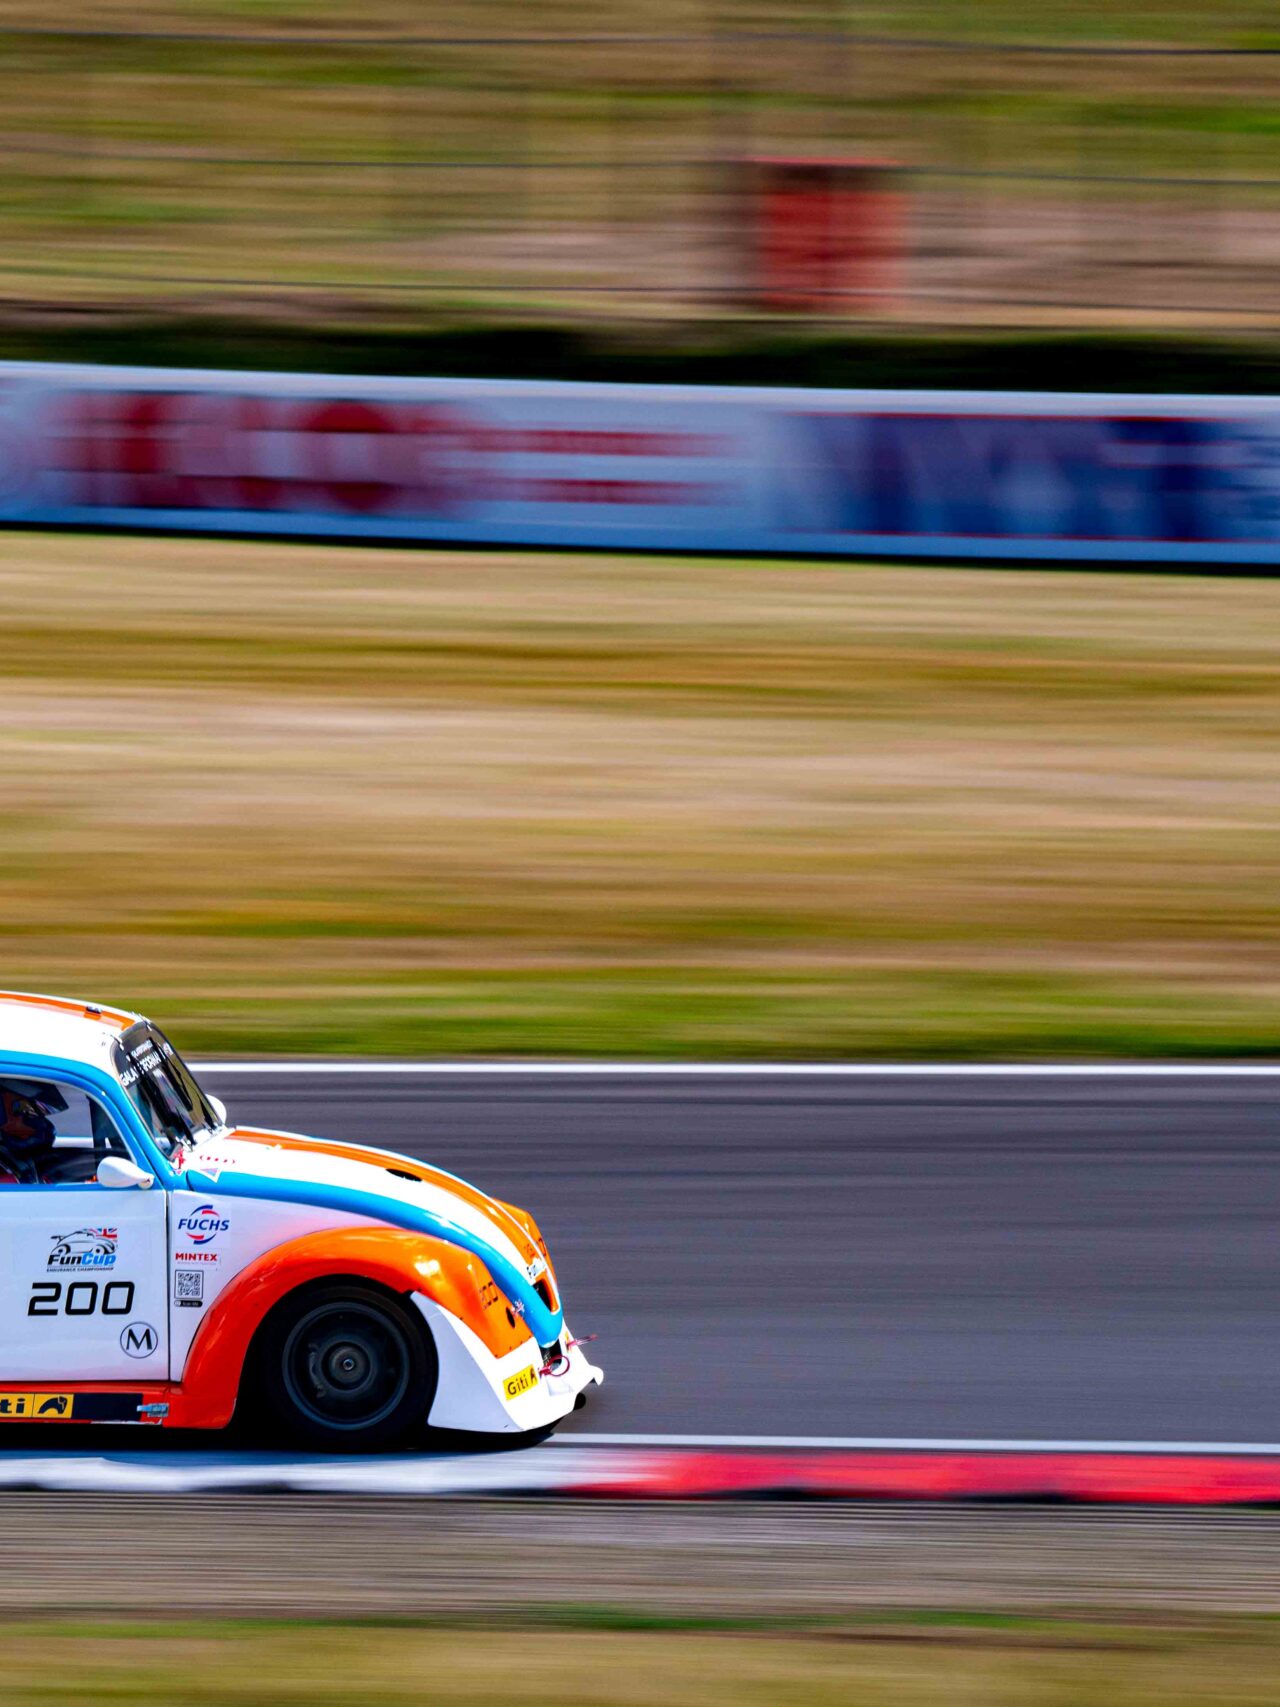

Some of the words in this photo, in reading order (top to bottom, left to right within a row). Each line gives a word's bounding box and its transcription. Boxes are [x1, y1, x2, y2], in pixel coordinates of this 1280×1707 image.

[178, 1218, 230, 1231] FUCHS
[47, 1252, 117, 1266] FunCup
[175, 1253, 218, 1262] MINTEX
[27, 1281, 135, 1316] 200
[126, 1328, 153, 1350] M
[507, 1374, 529, 1395] Giti
